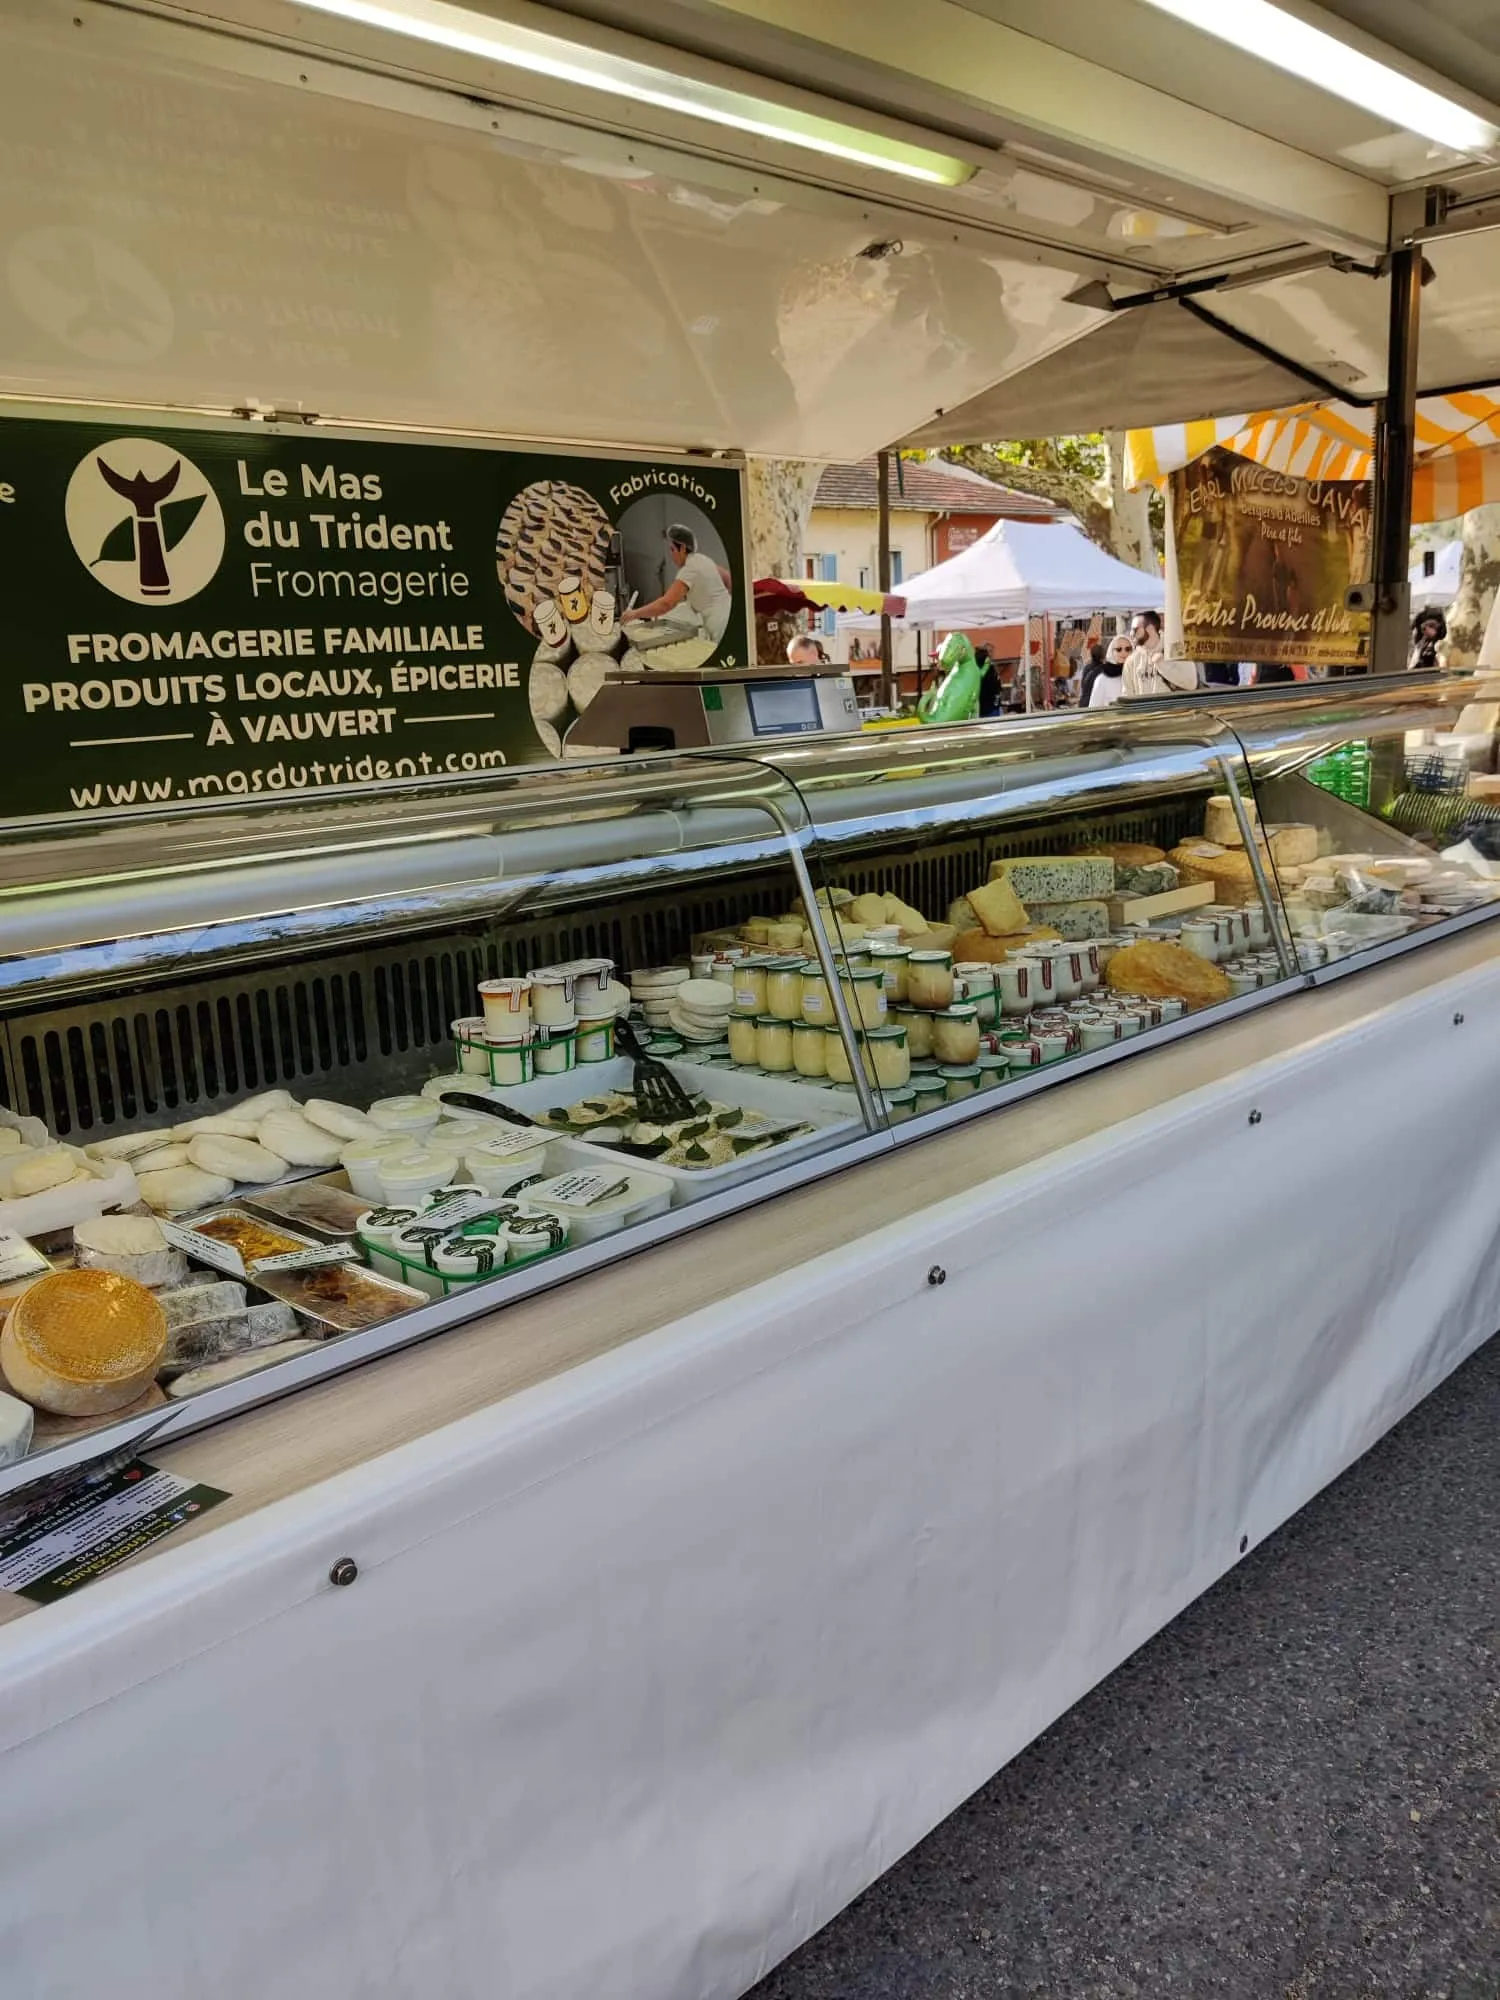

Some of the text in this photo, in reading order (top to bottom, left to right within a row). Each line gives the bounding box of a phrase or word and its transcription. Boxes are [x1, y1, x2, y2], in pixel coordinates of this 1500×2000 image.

[236, 459, 383, 500] Le Mas
[610, 468, 716, 511] Fabrication
[244, 511, 453, 550] du Trident
[249, 561, 470, 604] Fromagerie
[1183, 590, 1236, 627] Entre
[1241, 594, 1307, 632] Provence
[67, 625, 485, 663] FROMAGERIE FAMILIALE
[21, 661, 520, 713] PRODUITS LOCAUX, ÉPICERIE
[206, 707, 397, 747] À VAUVERT
[69, 746, 507, 808] www.masdutrident.com
[73, 1551, 95, 1562] 04
[125, 1521, 146, 1531] 20
